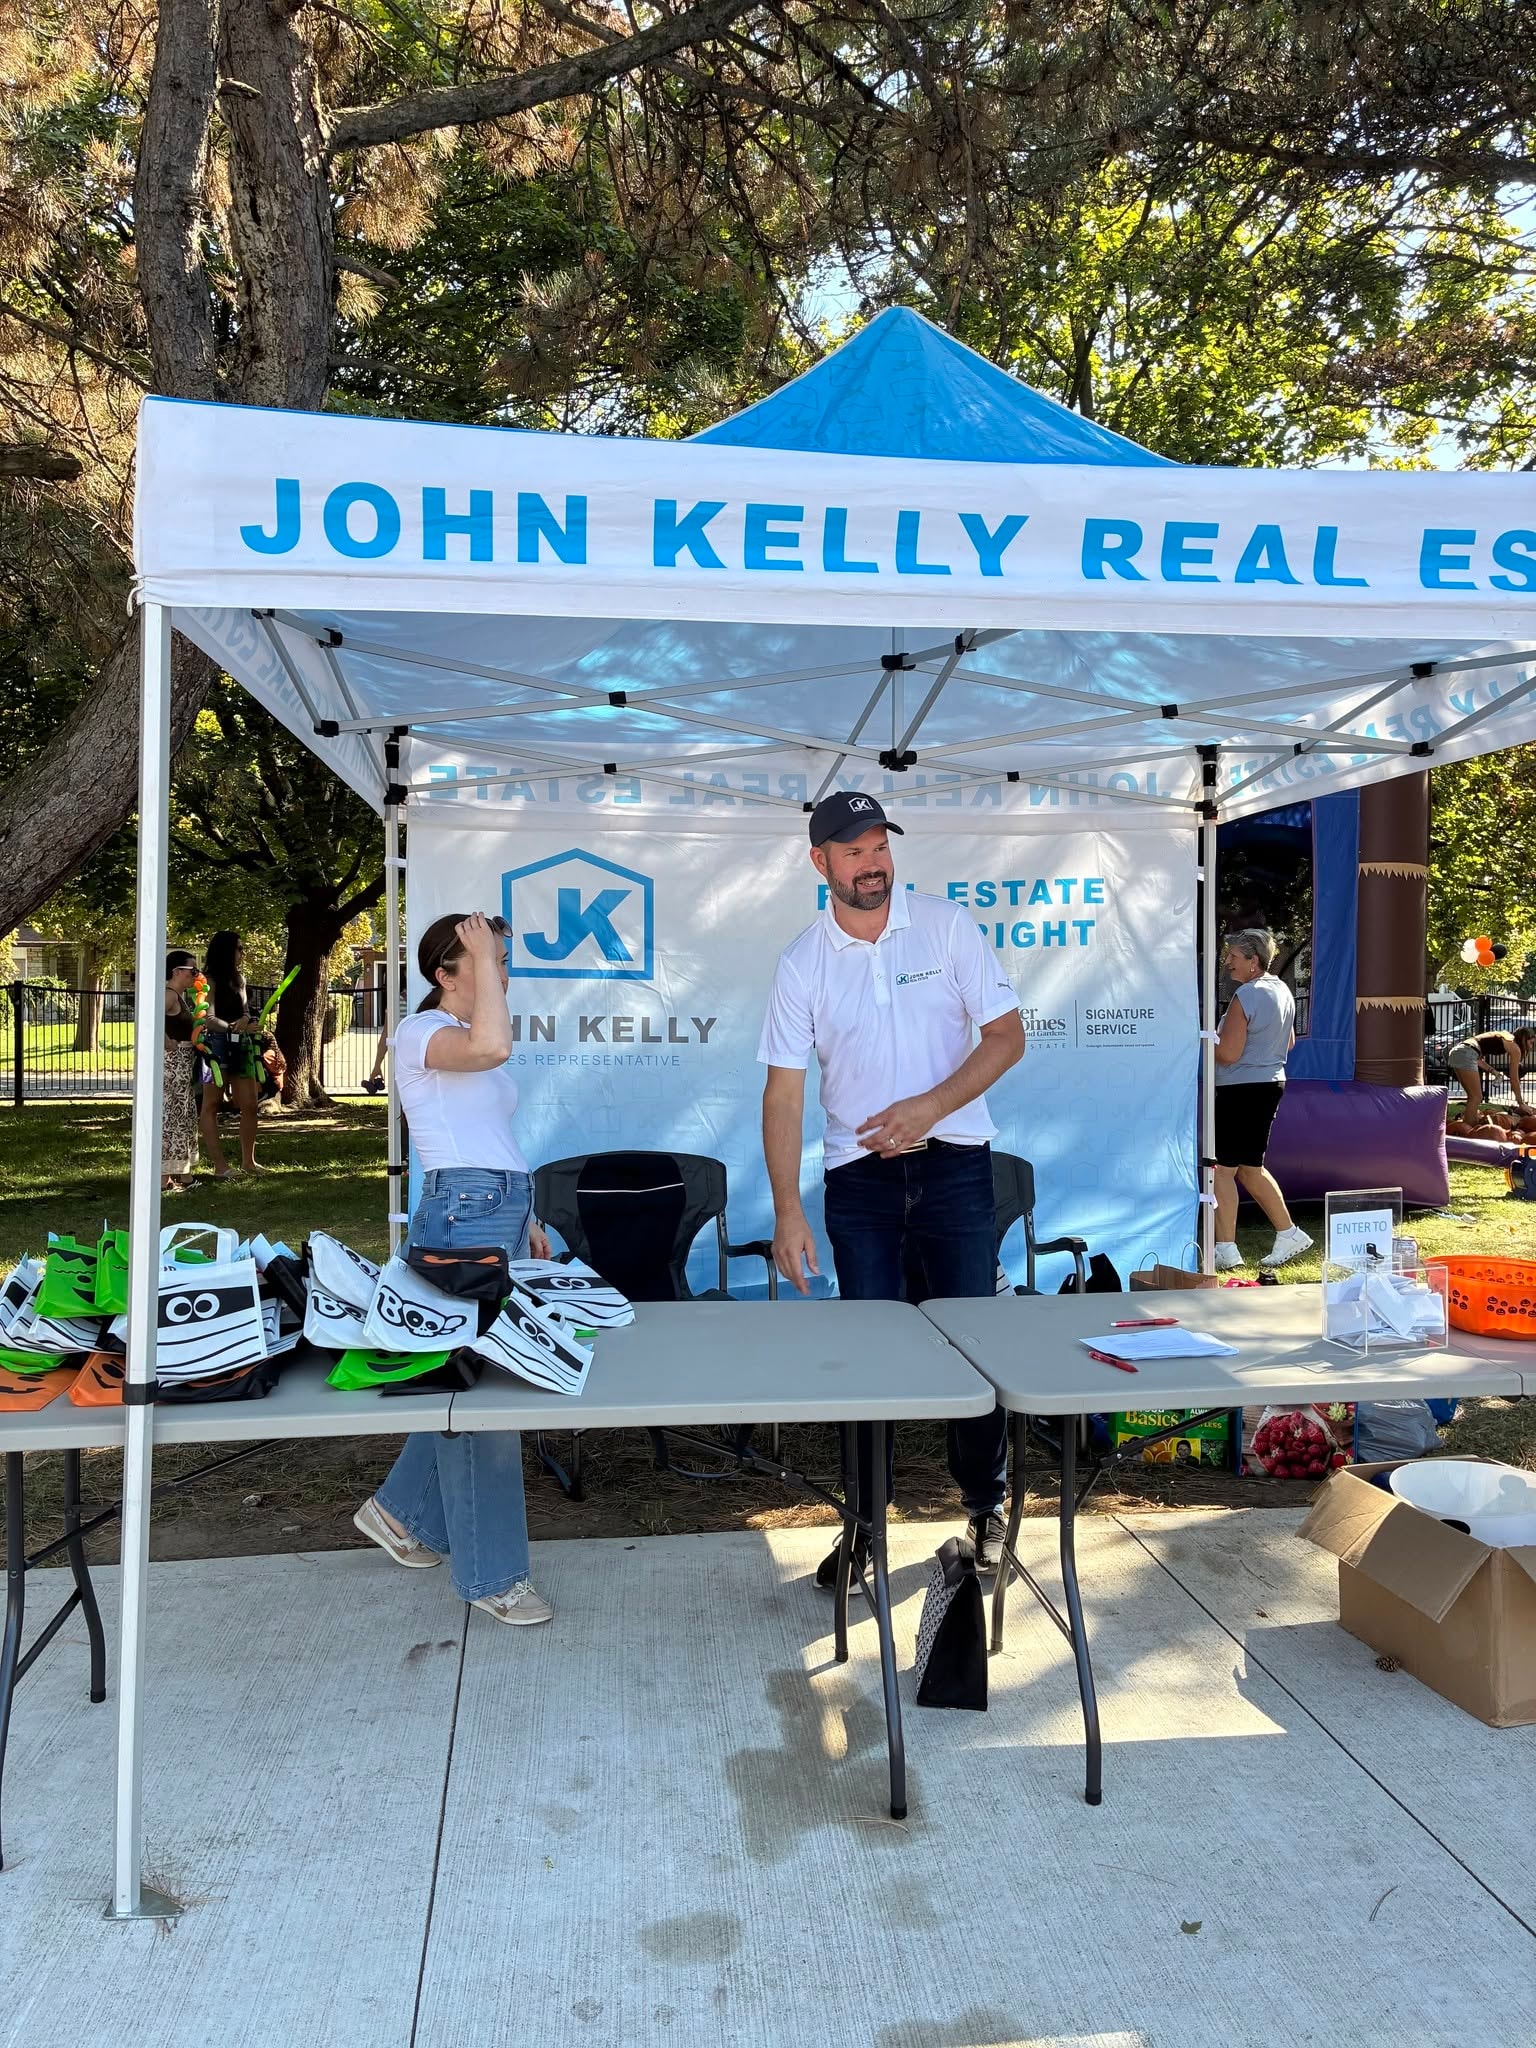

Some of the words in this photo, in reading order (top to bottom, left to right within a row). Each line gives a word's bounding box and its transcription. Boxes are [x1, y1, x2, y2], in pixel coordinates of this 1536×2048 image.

[239, 477, 588, 566] JOHN
[652, 498, 1031, 577] KELLY
[1080, 517, 1371, 588] REAL
[854, 800, 871, 810] JK
[947, 877, 1105, 908] ESTATE
[522, 887, 634, 962] JK
[925, 968, 943, 977] KELLY
[1018, 1007, 1038, 1020] er
[1085, 1008, 1155, 1020] SIGNATURE
[578, 1015, 718, 1044] KELLY
[1022, 1017, 1066, 1031] omes
[1086, 1023, 1138, 1035] SERVICE
[1030, 1042, 1067, 1050] STATE
[535, 1054, 681, 1067] REPRESENTATIVE
[1336, 1222, 1371, 1235] ENTER
[1372, 1220, 1388, 1232] TO
[1350, 1243, 1366, 1256] WI
[1124, 1410, 1180, 1427] Basics
